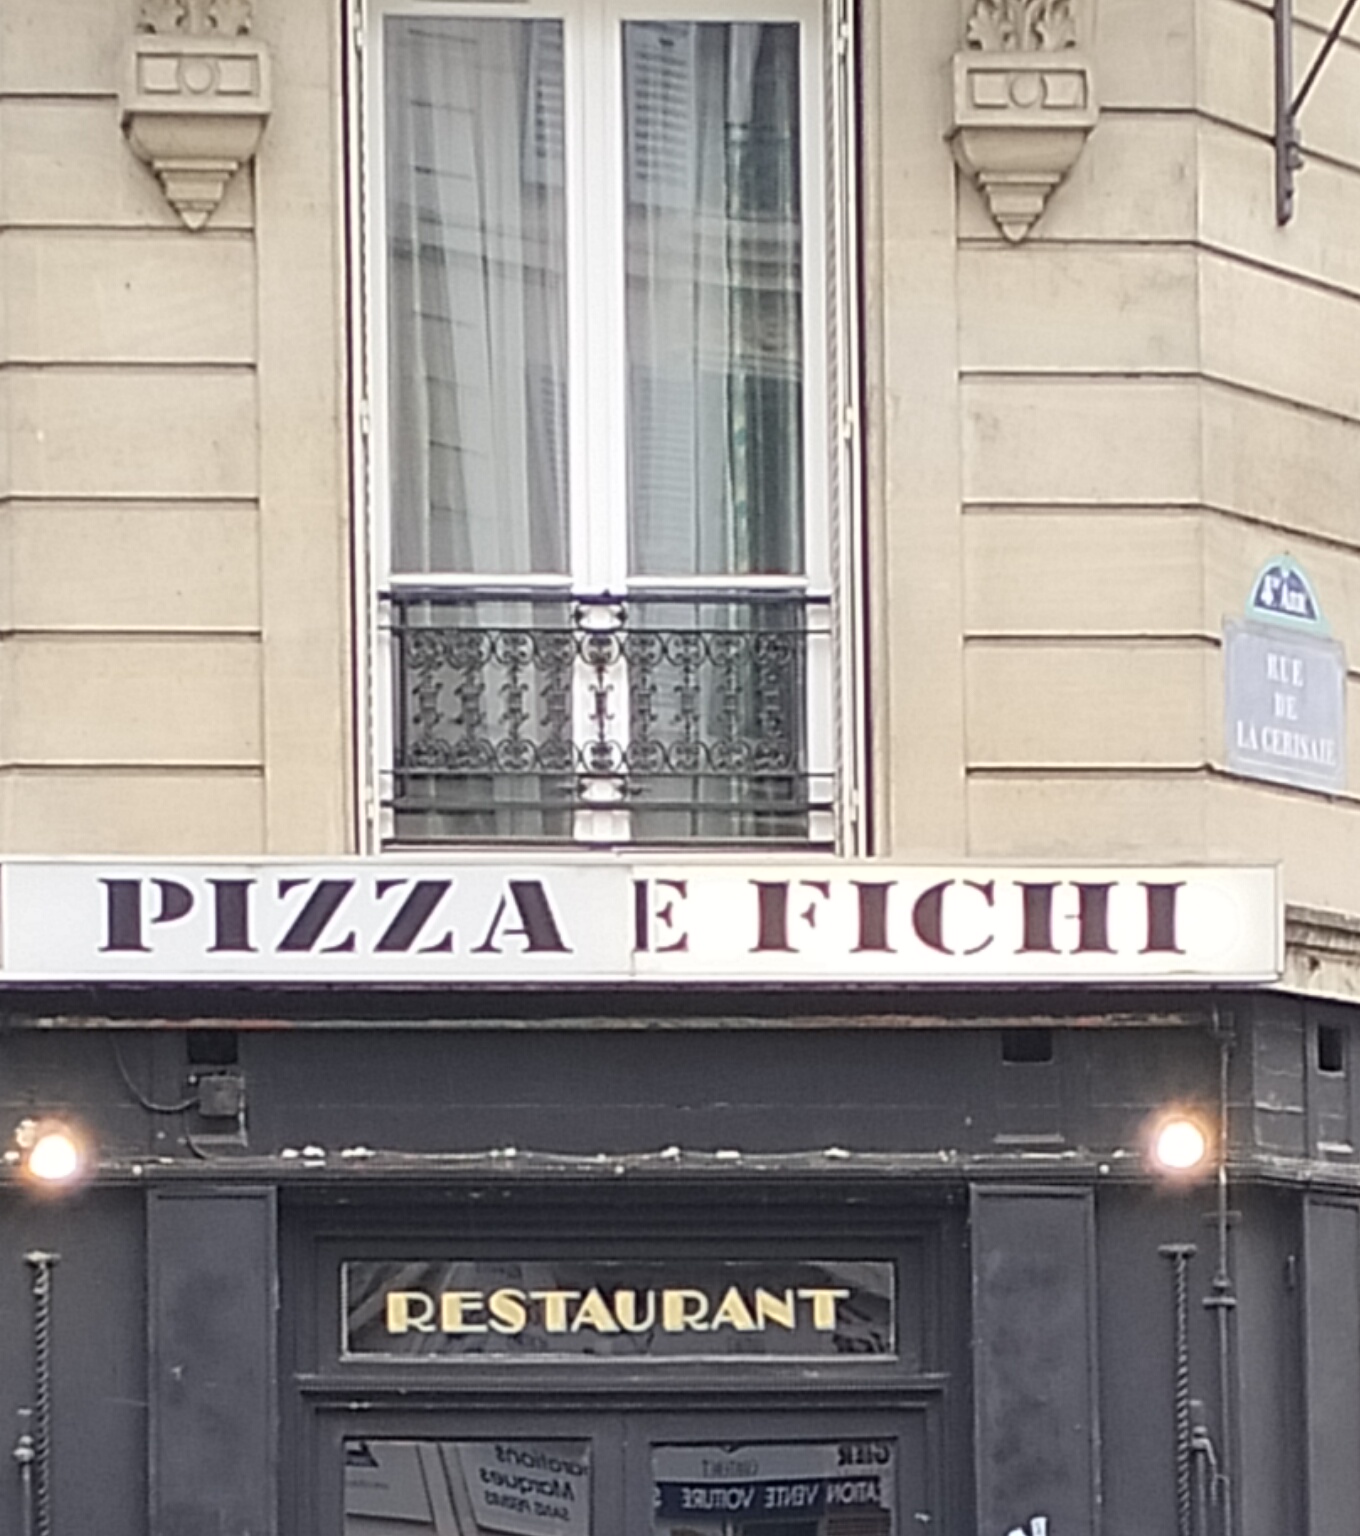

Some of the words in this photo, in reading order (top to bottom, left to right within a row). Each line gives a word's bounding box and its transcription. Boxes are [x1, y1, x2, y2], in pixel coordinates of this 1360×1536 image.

[1267, 652, 1303, 687] RUE
[1274, 692, 1298, 720] DE
[1237, 720, 1258, 750] LA
[1261, 726, 1336, 766] CERISAIE
[98, 876, 574, 955] PIZZA
[631, 876, 690, 955] E
[747, 876, 1189, 955] FICHI
[386, 1289, 849, 1334] RESTAURANT
